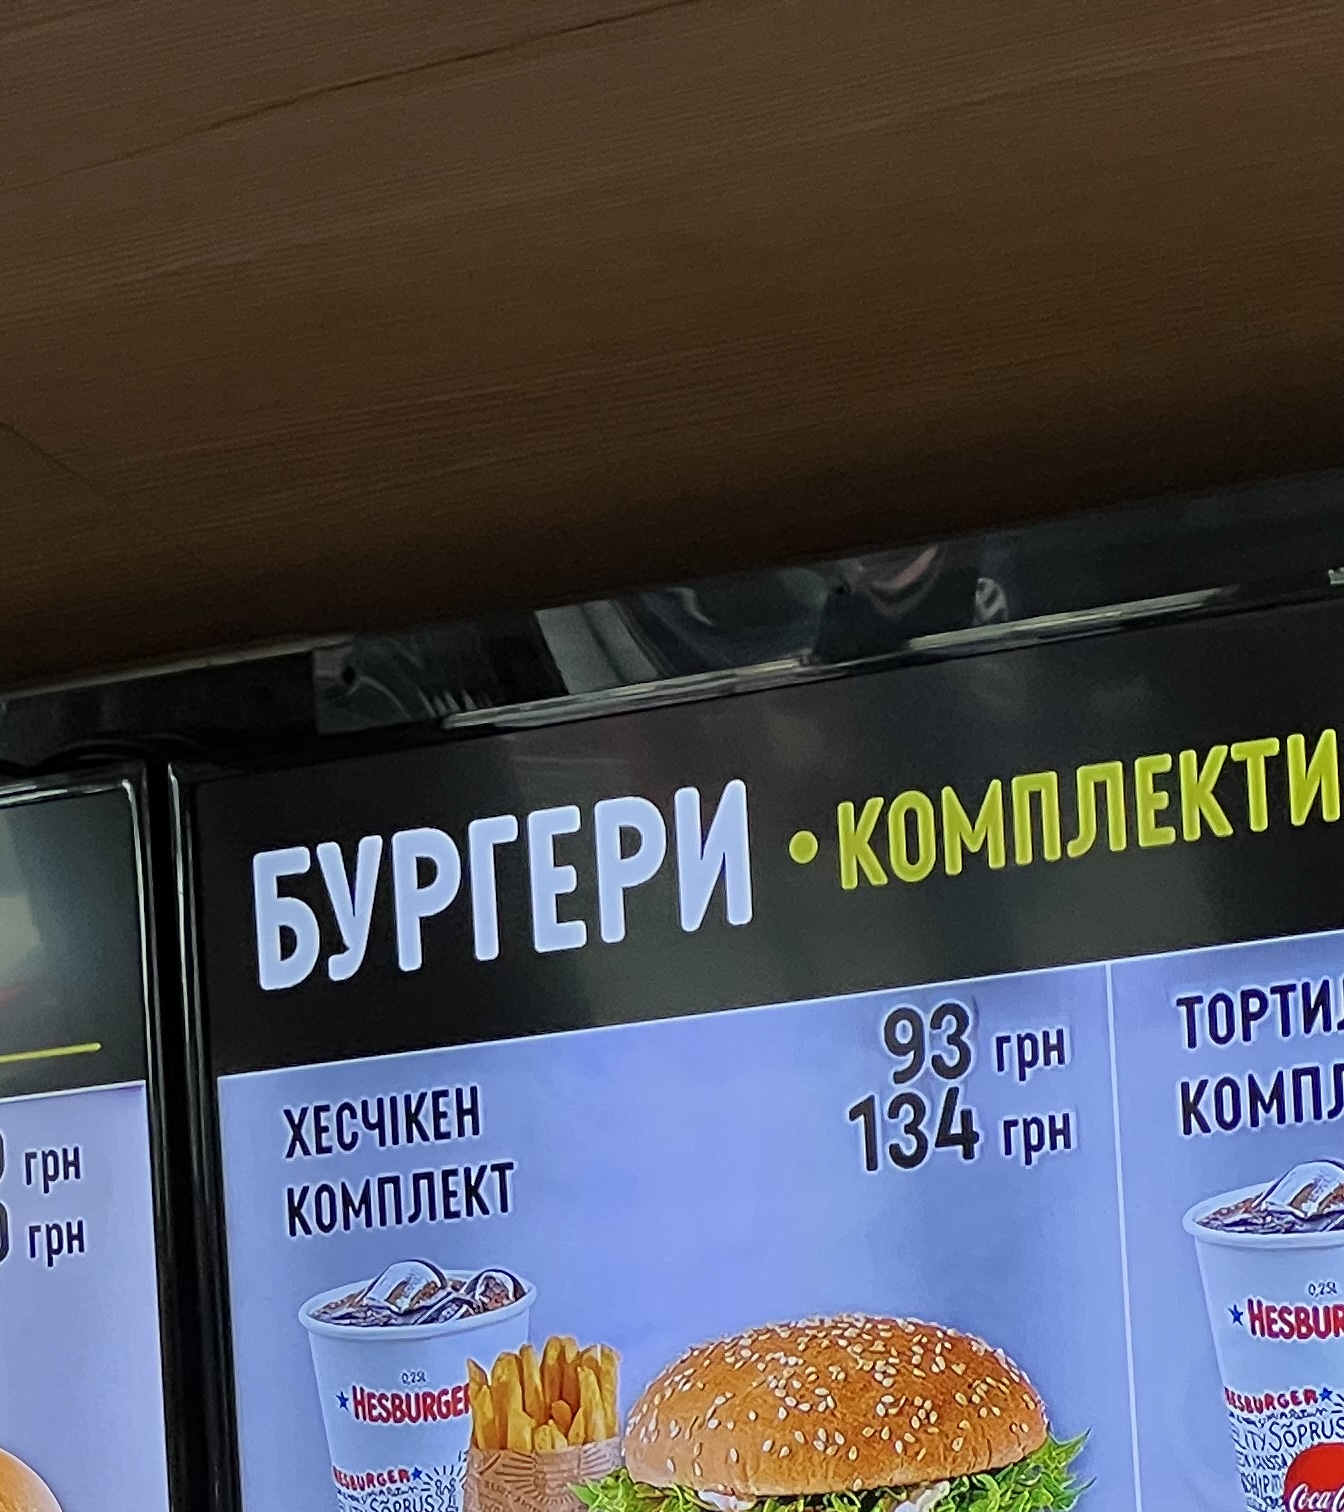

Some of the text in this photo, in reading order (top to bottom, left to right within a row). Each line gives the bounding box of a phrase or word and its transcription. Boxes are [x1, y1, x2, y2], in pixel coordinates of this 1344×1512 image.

[252, 728, 1341, 991] БУРГЕРИ КОМПЛЕКТИ
[883, 994, 1066, 1085] 93 грн
[1175, 979, 1344, 1049] ТОРТИ
[283, 1085, 480, 1159] ХЕСЧІКЕН
[848, 1086, 1072, 1172] 134 грн
[24, 1146, 81, 1194] грн
[287, 1161, 514, 1237] КОМПЛЕКТ
[28, 1219, 85, 1268] грн
